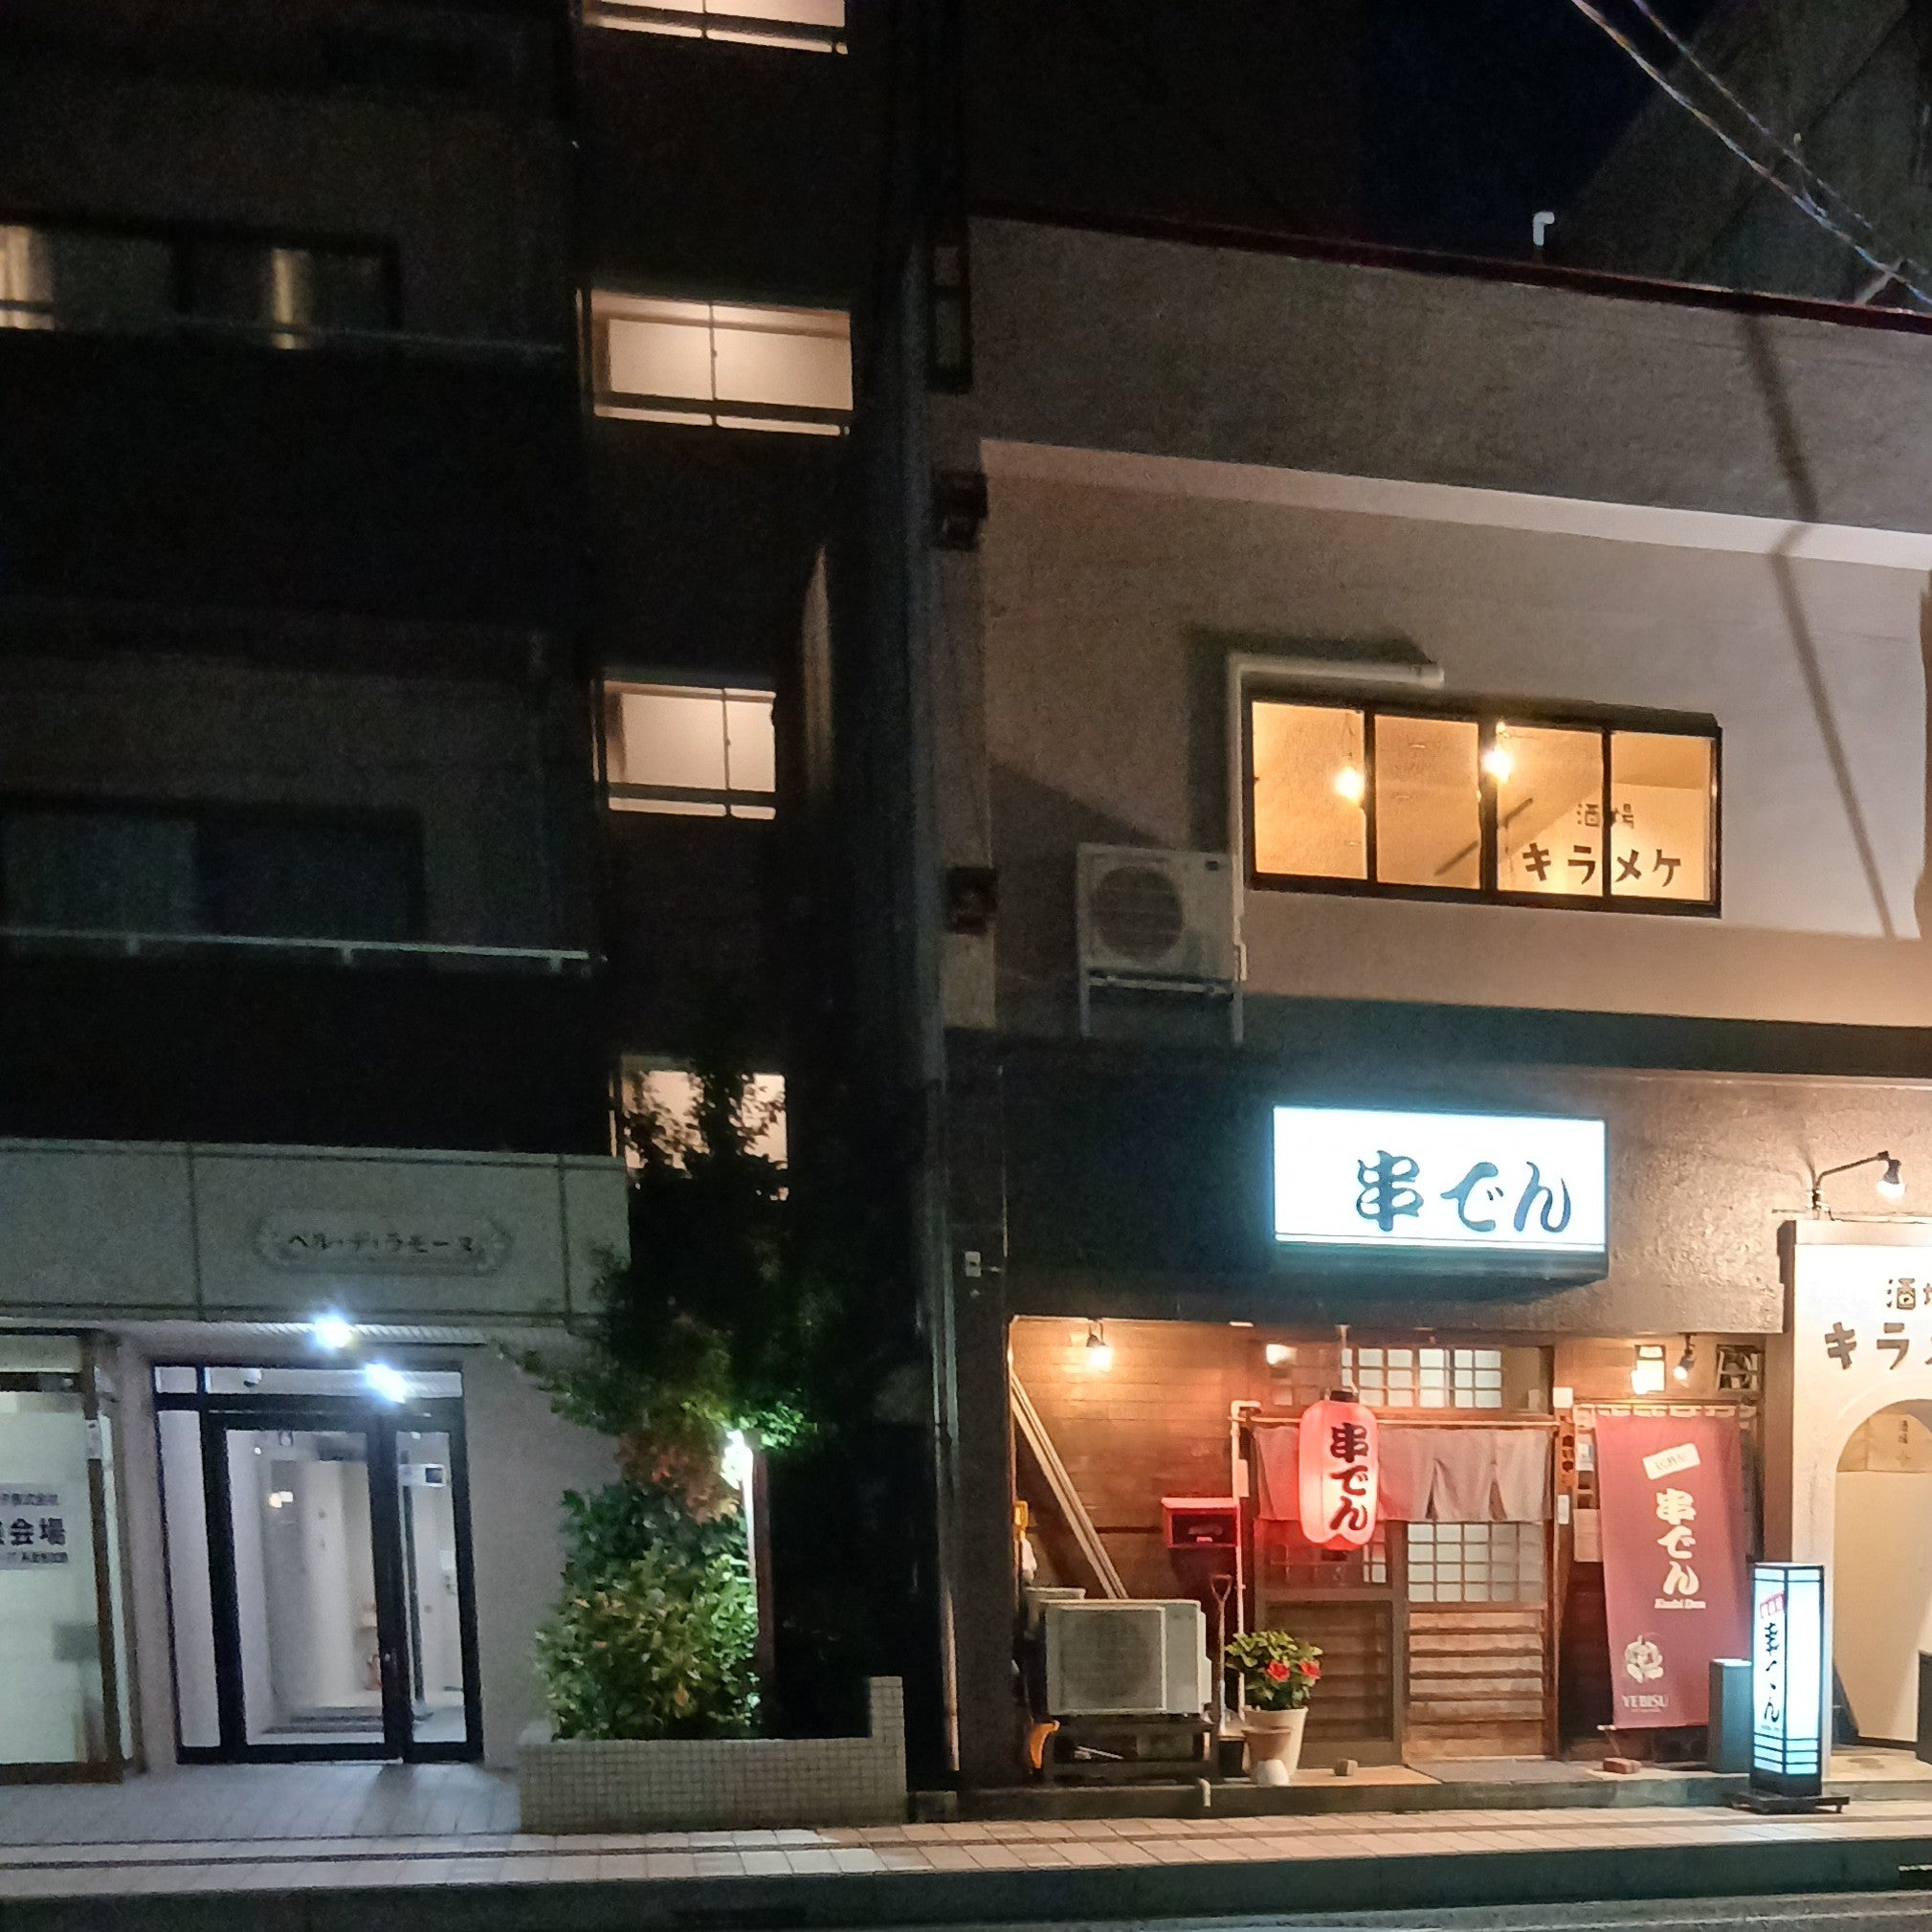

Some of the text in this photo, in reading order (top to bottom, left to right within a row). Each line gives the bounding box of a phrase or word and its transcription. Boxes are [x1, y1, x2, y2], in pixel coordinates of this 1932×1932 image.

[1576, 802, 1634, 829] 酒場
[1521, 841, 1682, 888] キラメケ
[1355, 1149, 1572, 1233] 串でん
[1824, 1321, 1932, 1370] キラ
[1329, 1421, 1369, 1531] 串でん
[0, 1517, 66, 1546] 会場
[1655, 1487, 1698, 1596] 串でん
